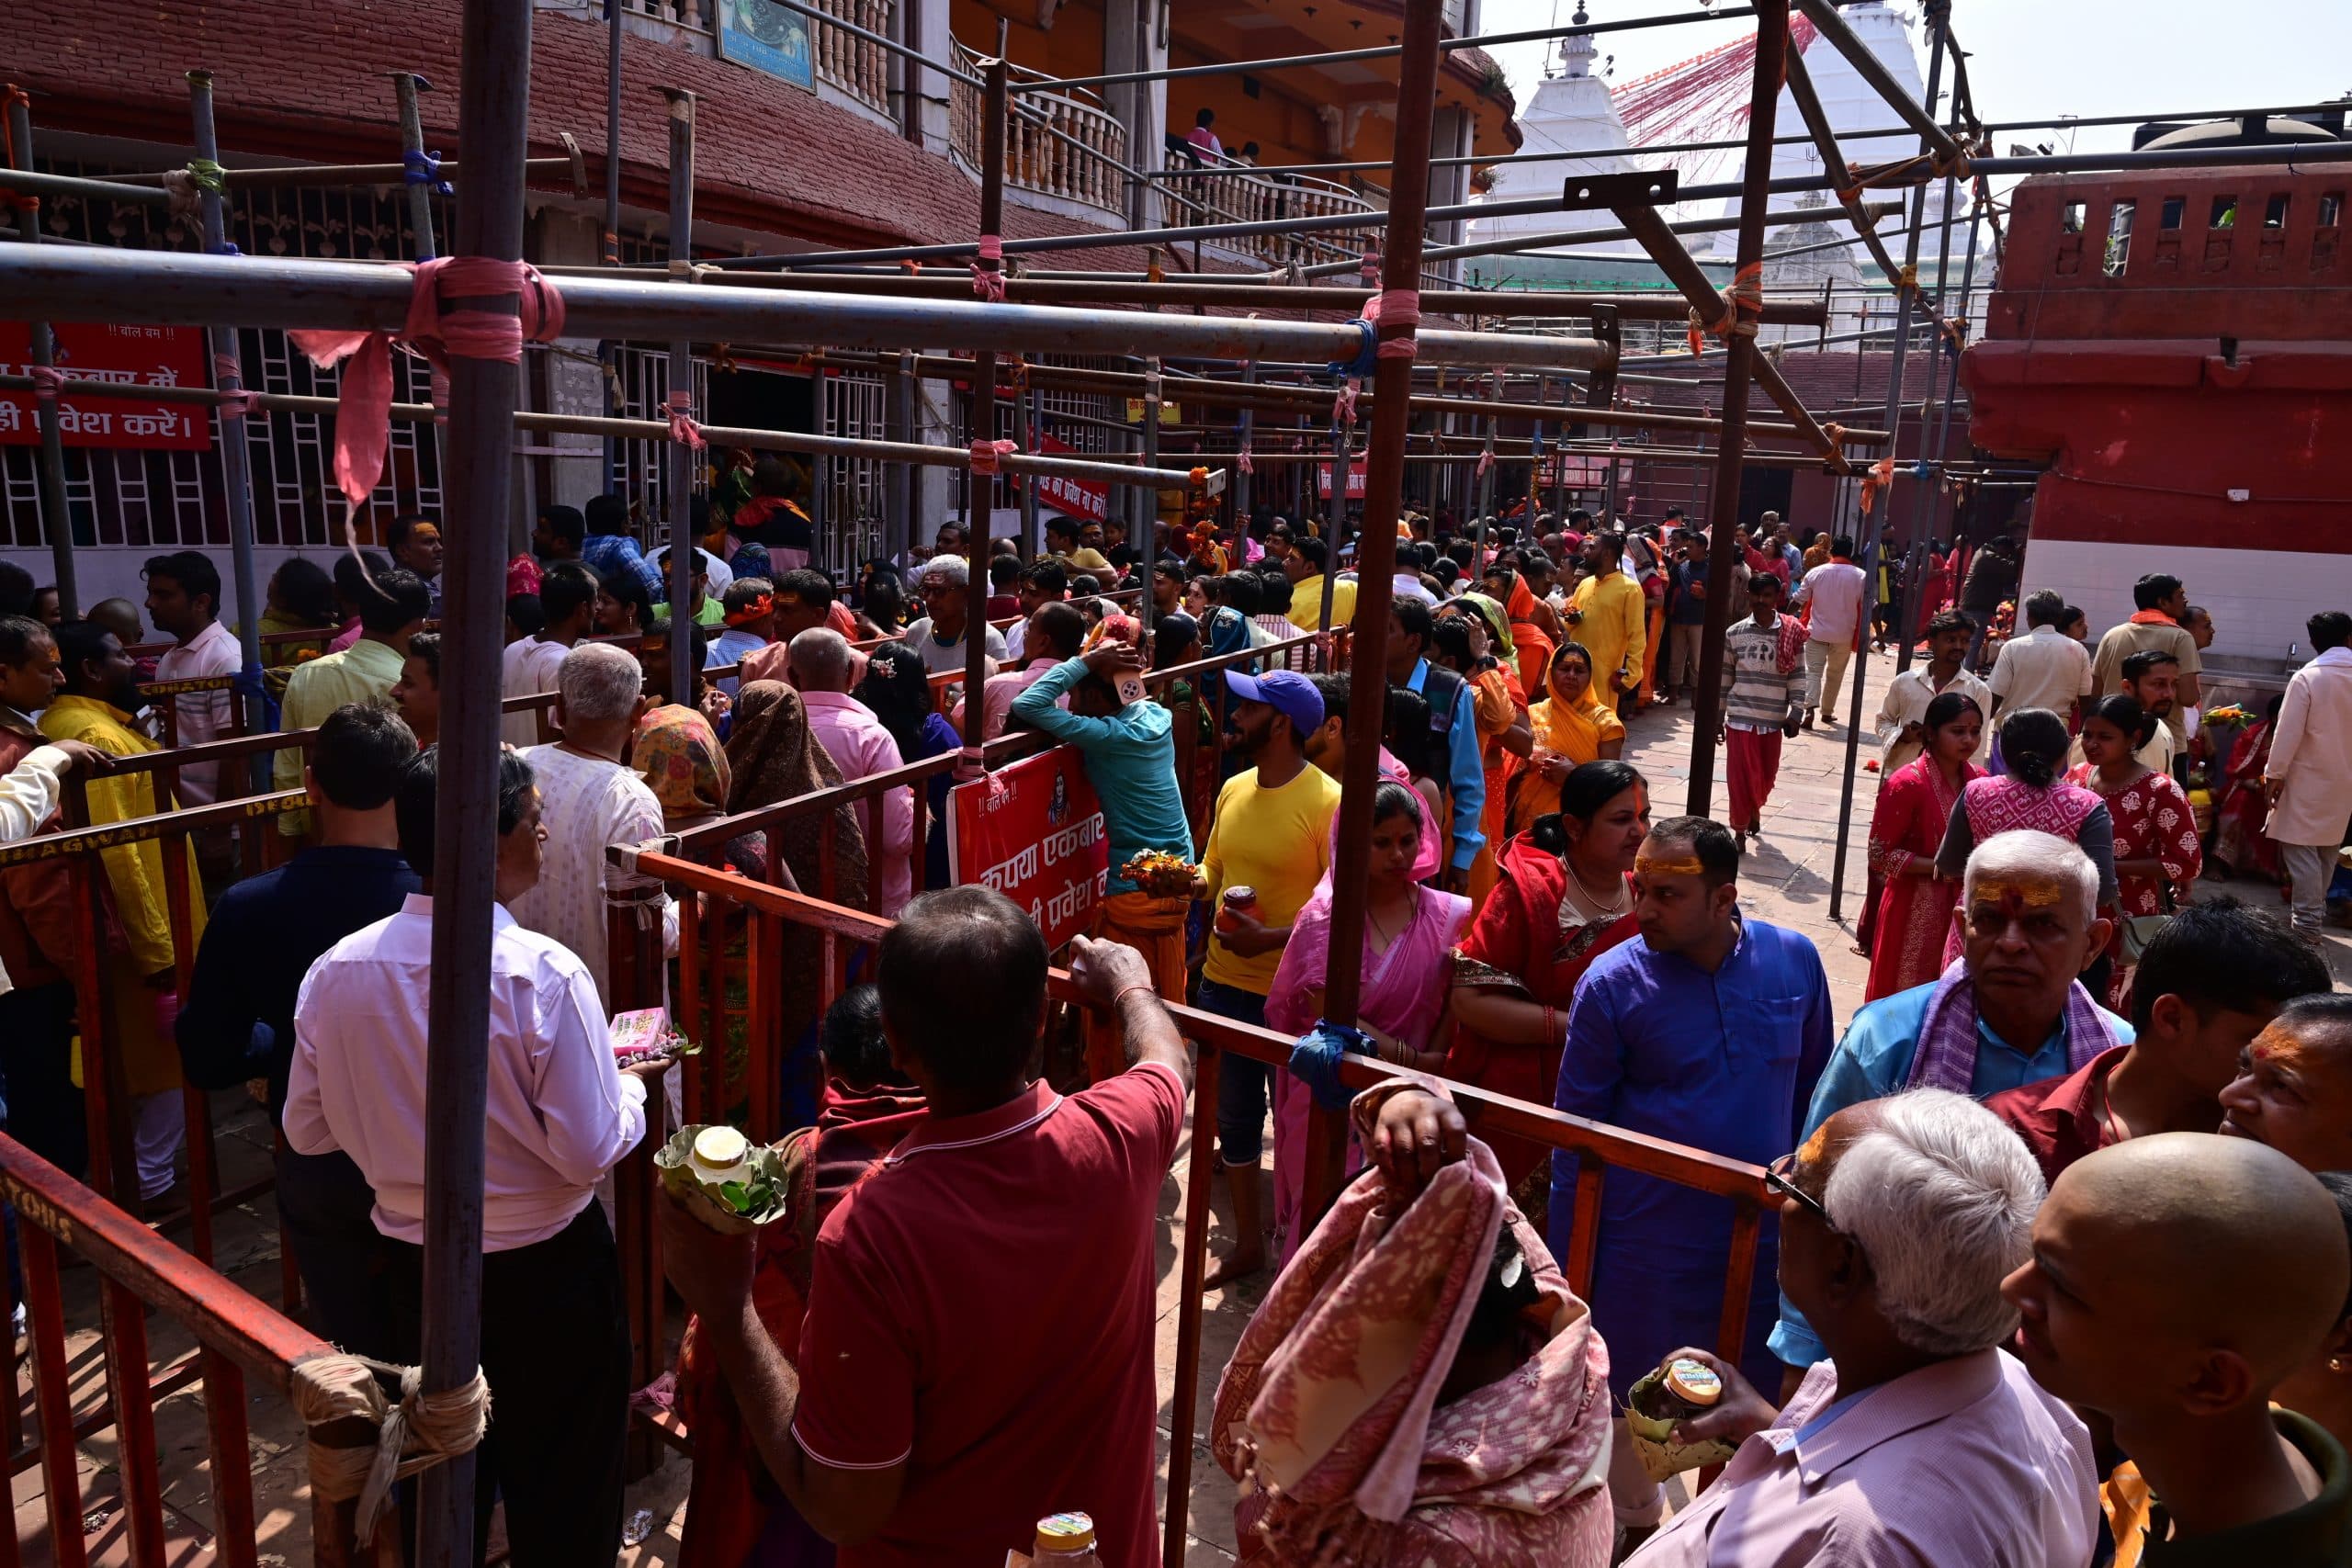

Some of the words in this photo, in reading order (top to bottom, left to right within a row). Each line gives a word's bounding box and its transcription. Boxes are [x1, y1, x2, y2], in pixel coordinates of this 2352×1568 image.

[980, 842, 1038, 892] कपया
[1043, 811, 1105, 867] एकबार
[1047, 879, 1093, 932] प्रवेश
